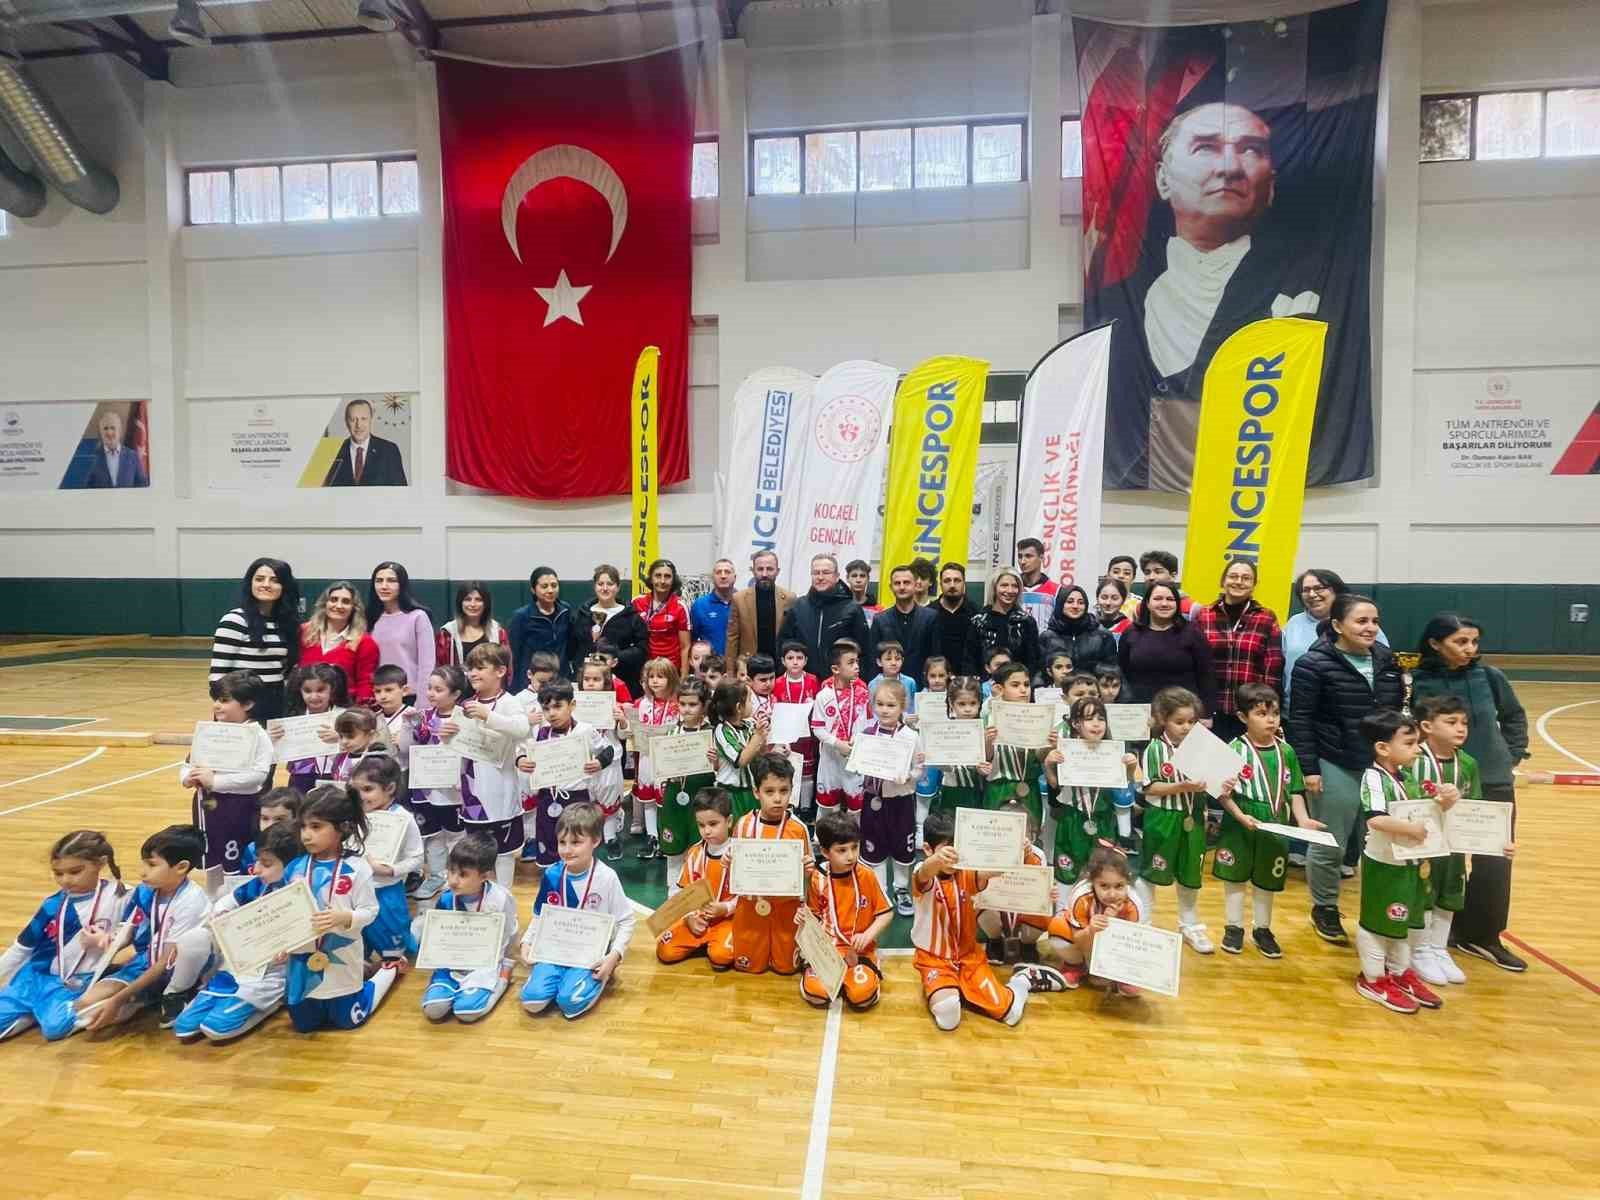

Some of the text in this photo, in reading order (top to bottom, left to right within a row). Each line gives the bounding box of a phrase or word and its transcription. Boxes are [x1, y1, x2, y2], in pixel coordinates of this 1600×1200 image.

[1447, 418, 1471, 429] TÜM
[1537, 418, 1551, 429] VE
[1448, 429, 1546, 440] SPORCULARIMIZA
[1046, 434, 1061, 464] VE
[1442, 440, 1496, 450] BAŞARILAR
[501, 822, 512, 843] 7
[225, 840, 240, 860] 8
[1272, 856, 1285, 878] 8
[854, 964, 868, 984] 8
[979, 976, 999, 1005] 7
